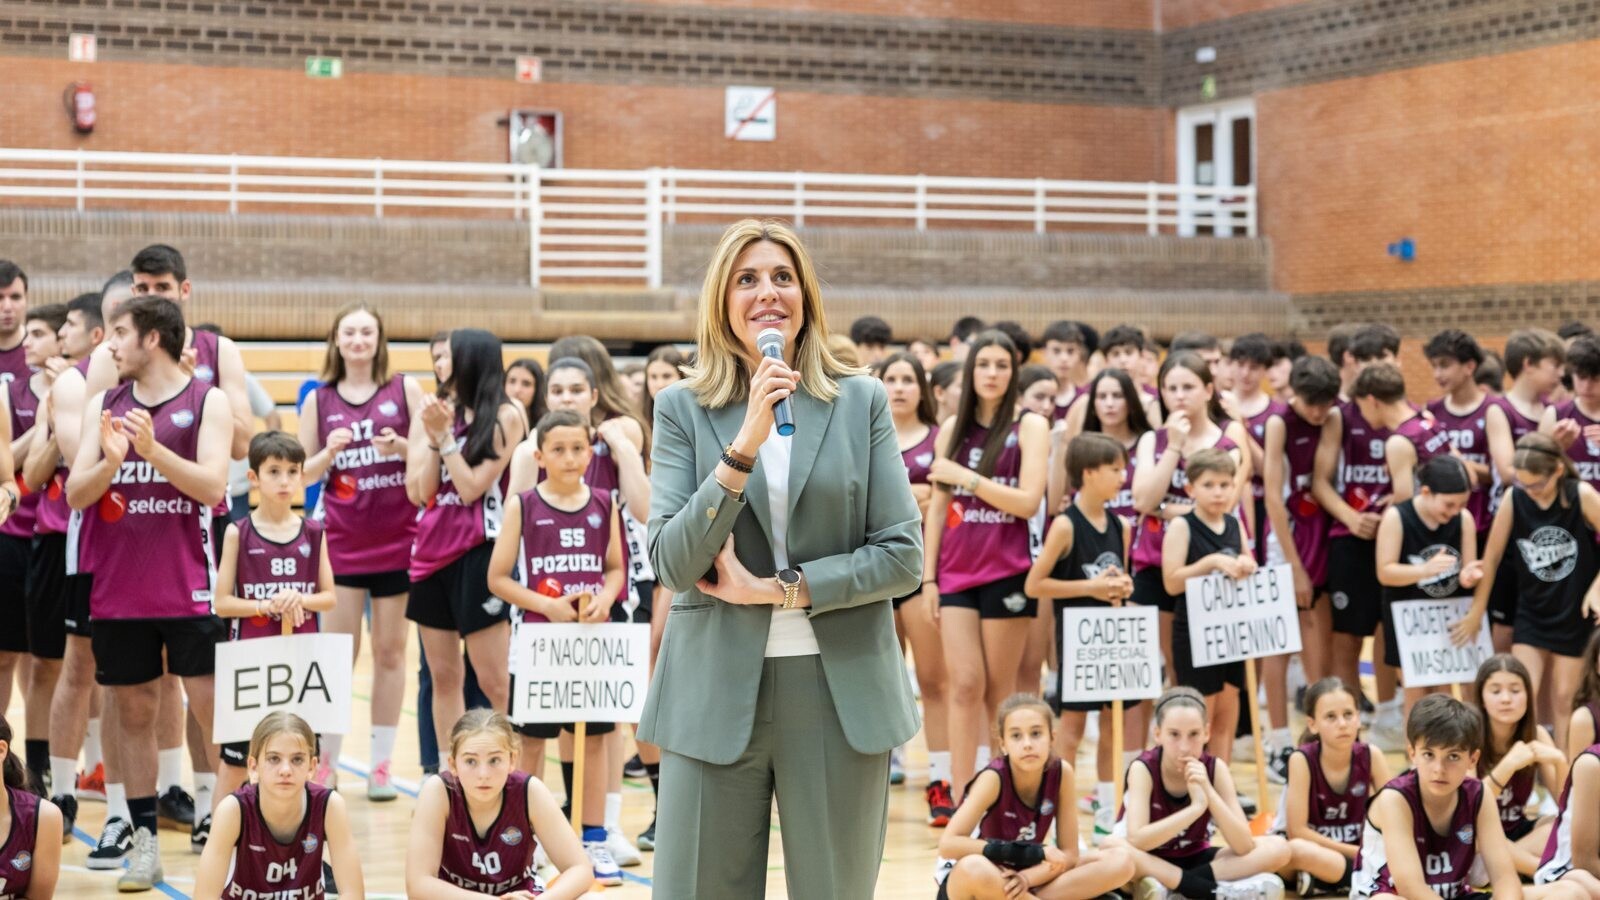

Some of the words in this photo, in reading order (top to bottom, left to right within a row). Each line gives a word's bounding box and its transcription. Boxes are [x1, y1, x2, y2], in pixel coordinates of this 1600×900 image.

[351, 419, 374, 442] 17
[127, 496, 192, 515] selecta
[559, 527, 585, 548] 55
[271, 557, 297, 576] 88
[531, 553, 603, 575] POZUEL
[1268, 568, 1280, 602] B
[1078, 617, 1147, 645] CADETE
[1204, 615, 1288, 661] FEMENINO
[549, 637, 634, 666] NACIONAL
[1076, 646, 1148, 661] ESPECIAL
[234, 661, 332, 711] EBA
[1074, 662, 1152, 691] FEMENINO
[527, 680, 634, 709] FEMENINO
[265, 857, 298, 883] 04
[471, 851, 502, 875] 40
[1426, 851, 1453, 876] 01
